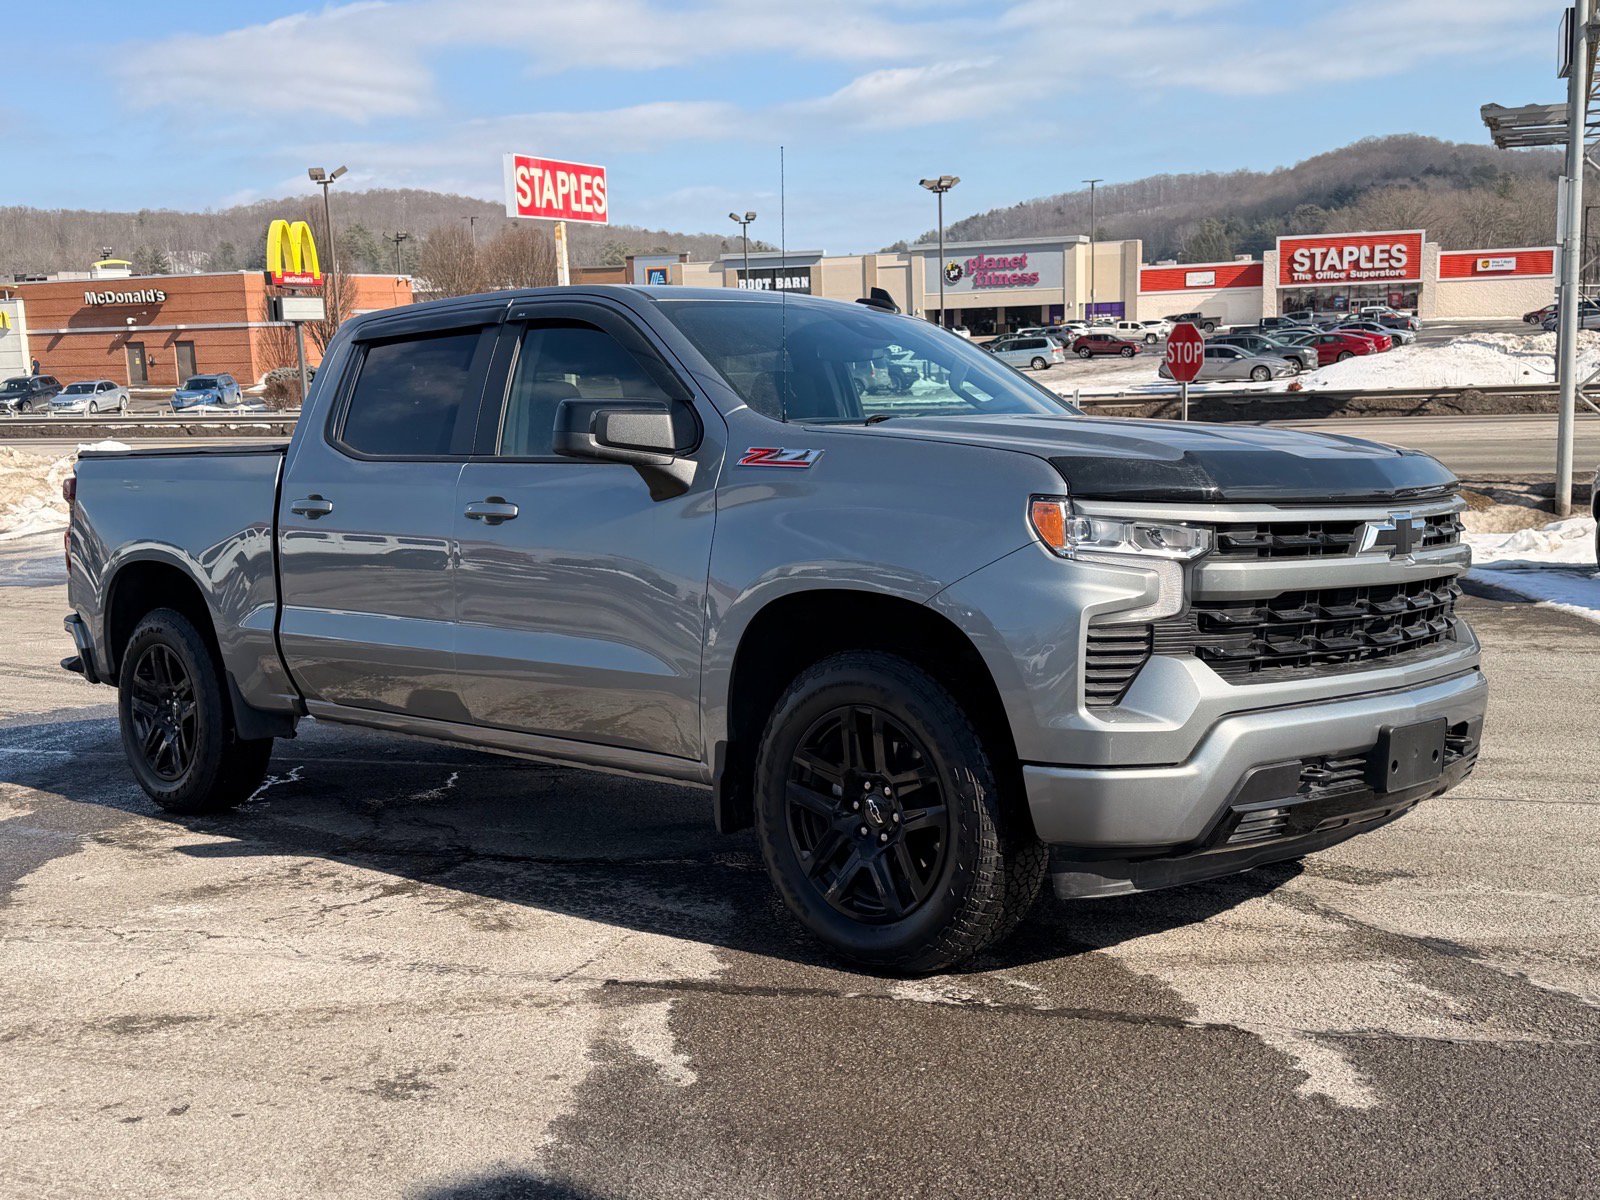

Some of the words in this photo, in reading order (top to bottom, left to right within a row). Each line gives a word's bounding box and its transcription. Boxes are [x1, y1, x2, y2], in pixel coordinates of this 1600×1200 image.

[516, 165, 606, 215] STAPLES
[966, 252, 1028, 275] planet
[1292, 243, 1408, 272] STAPLES
[738, 278, 771, 290] BOOT
[775, 276, 809, 289] BARN
[975, 271, 1040, 286] fitness
[1292, 272, 1312, 281] The
[1315, 270, 1346, 280] Office
[1350, 269, 1407, 279] Superstore
[84, 289, 166, 305] McDonald's
[1167, 341, 1202, 364] STOP
